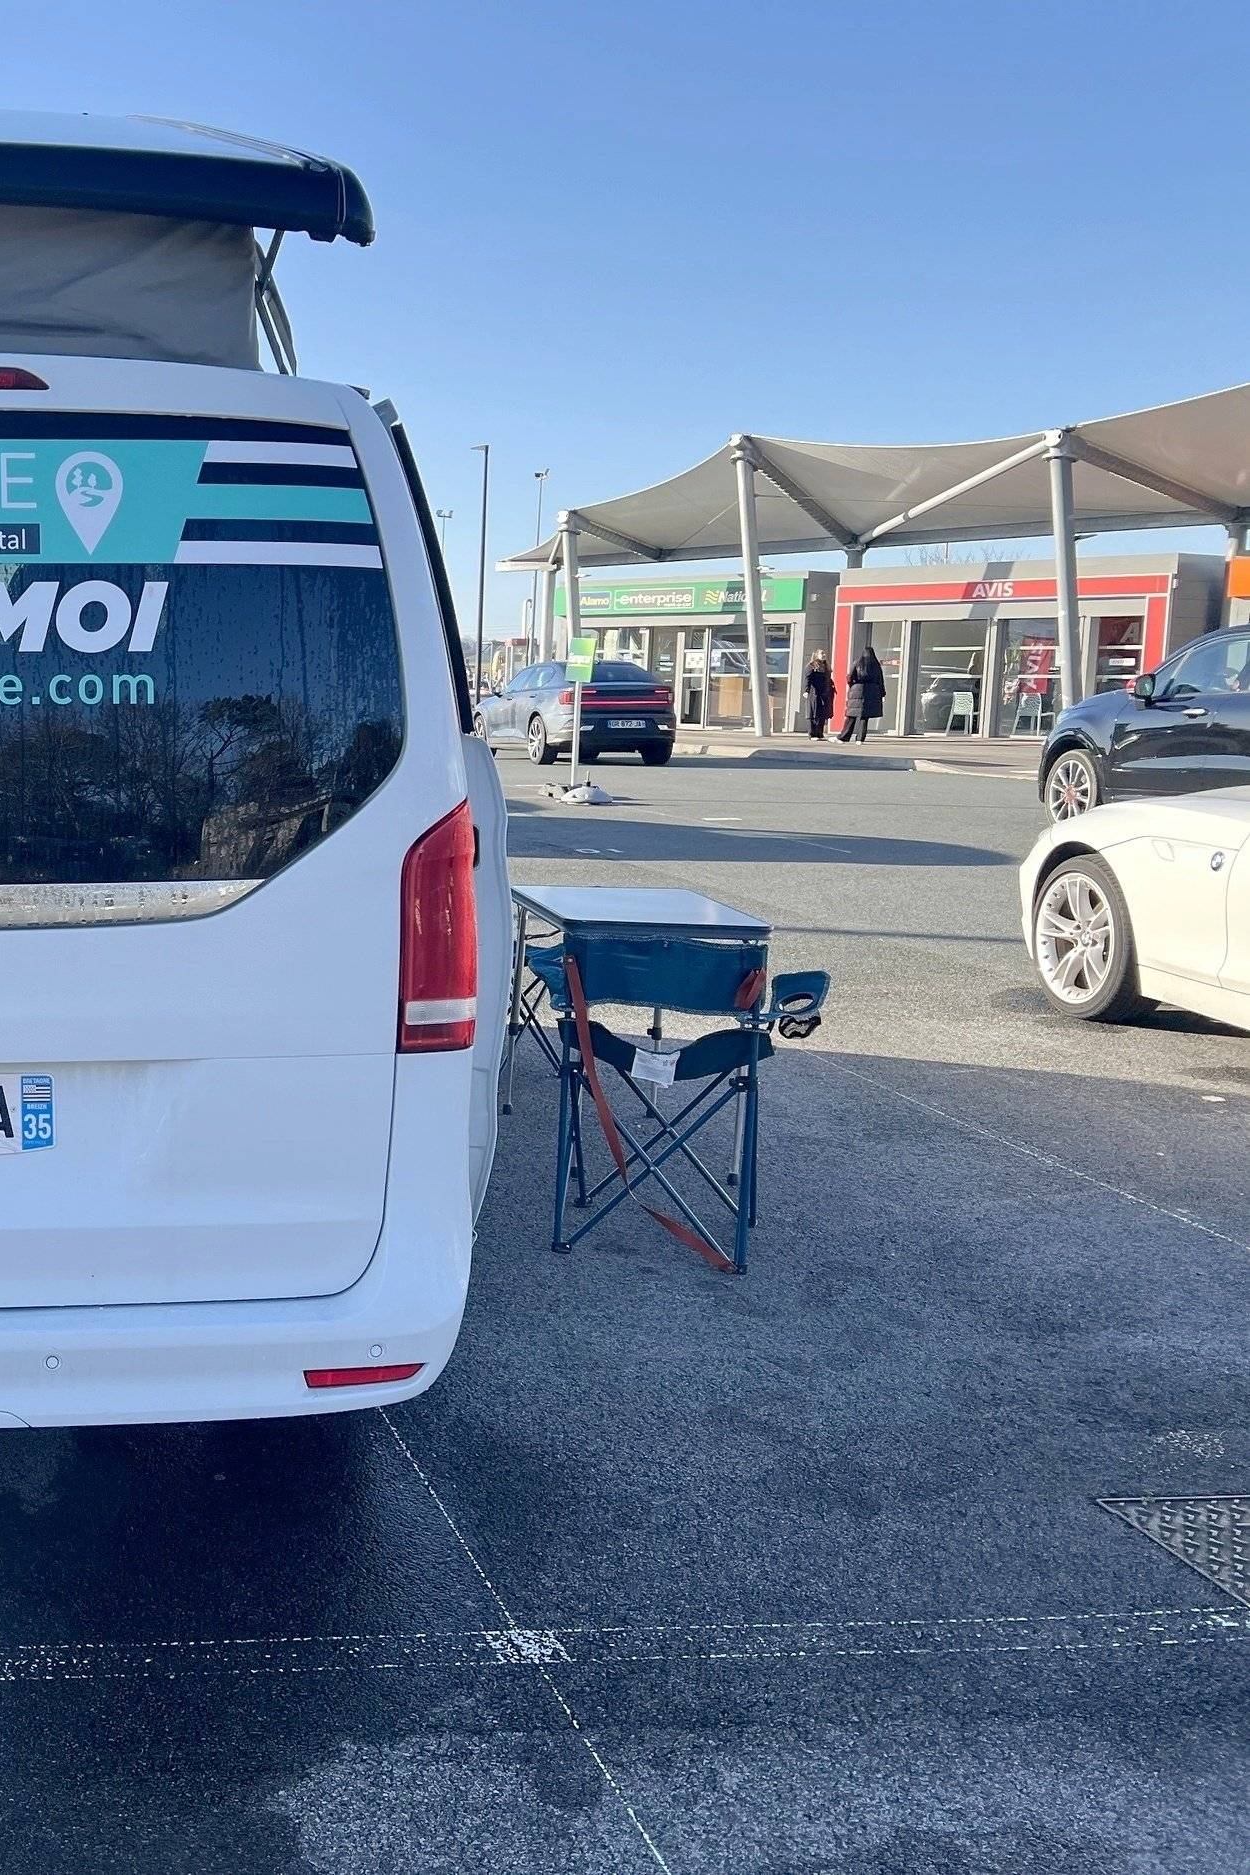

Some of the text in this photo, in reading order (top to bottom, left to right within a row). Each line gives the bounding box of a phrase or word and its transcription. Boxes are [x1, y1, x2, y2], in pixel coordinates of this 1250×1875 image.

[972, 582, 1014, 598] AVIS
[619, 591, 692, 606] enterprise
[23, 1113, 52, 1140] 35
